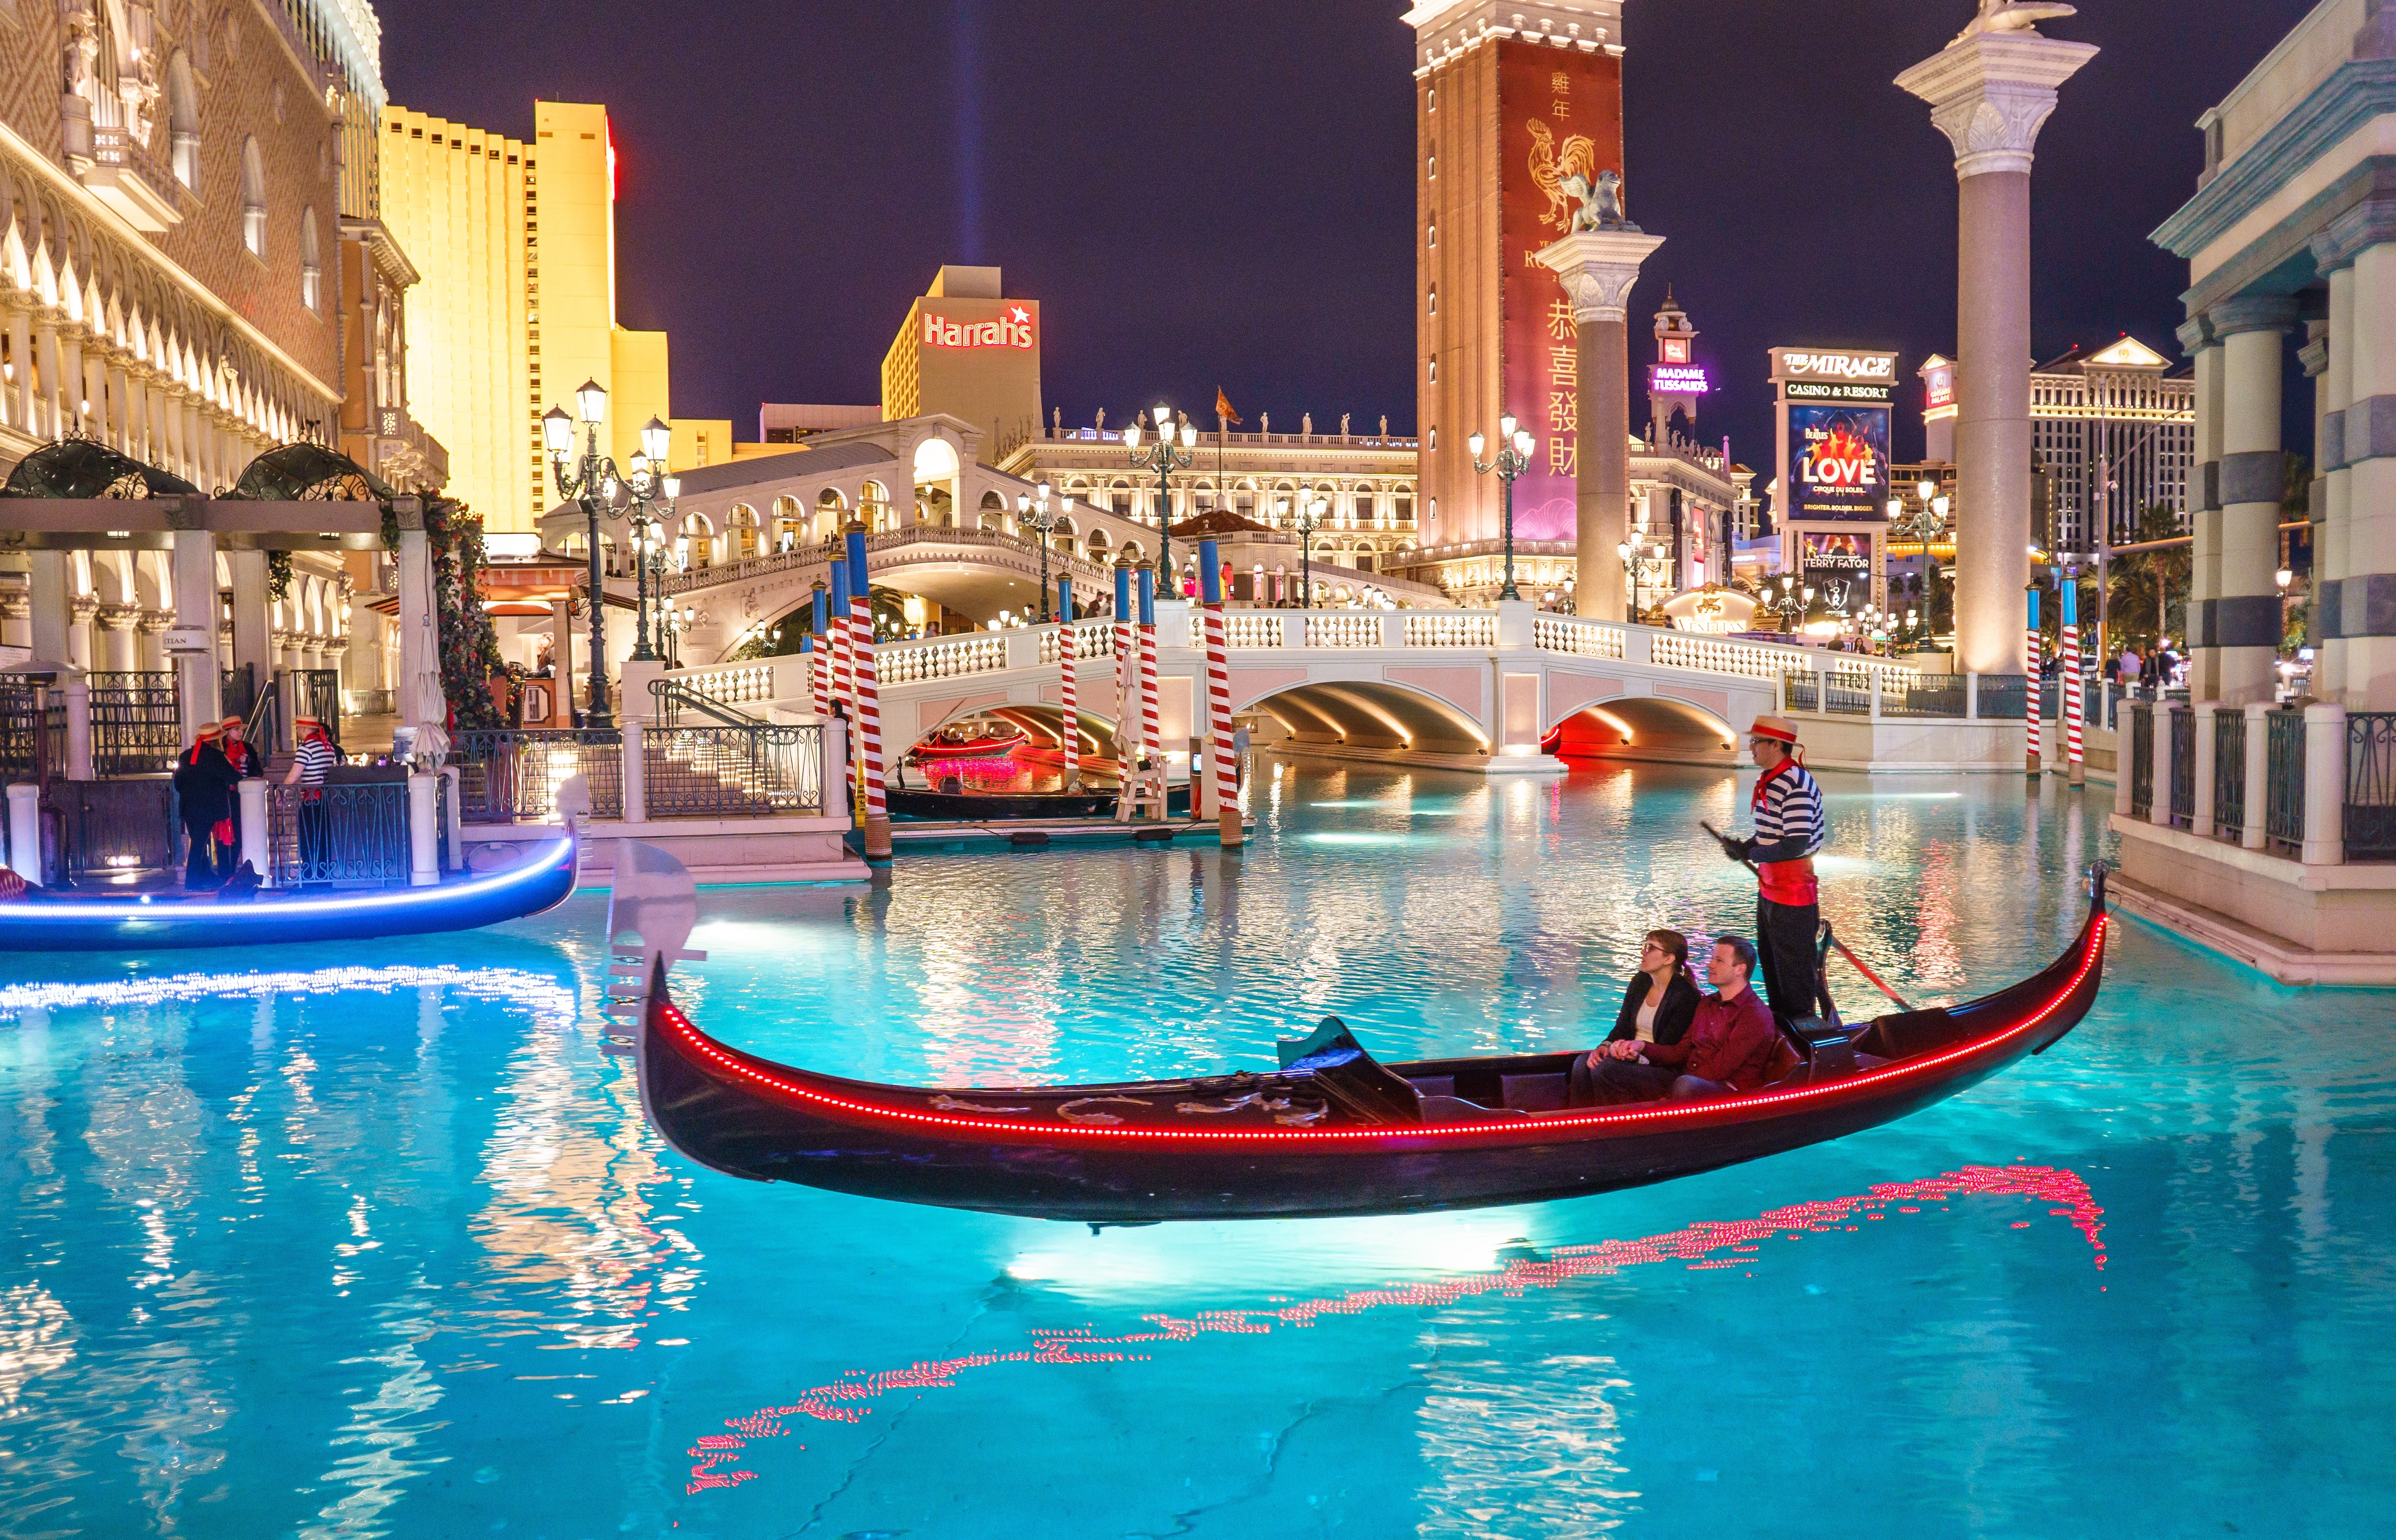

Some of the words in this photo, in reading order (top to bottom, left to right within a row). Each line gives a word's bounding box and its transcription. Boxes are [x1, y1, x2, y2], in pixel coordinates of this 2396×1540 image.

[1551, 73, 1570, 121] 雞年
[1783, 353, 1809, 366] THE
[1790, 354, 1891, 378] MIRAGE
[1657, 368, 1705, 380] MADAME
[1787, 384, 1830, 396] CASINO
[1832, 386, 1842, 396] &
[1843, 386, 1888, 398] RESORT
[1805, 428, 1828, 440] BEATLES
[1803, 457, 1877, 484] LOVE
[1804, 559, 1835, 568] TERRY
[1838, 559, 1869, 568] FATOR
[1678, 617, 1745, 632] VENETIAN
